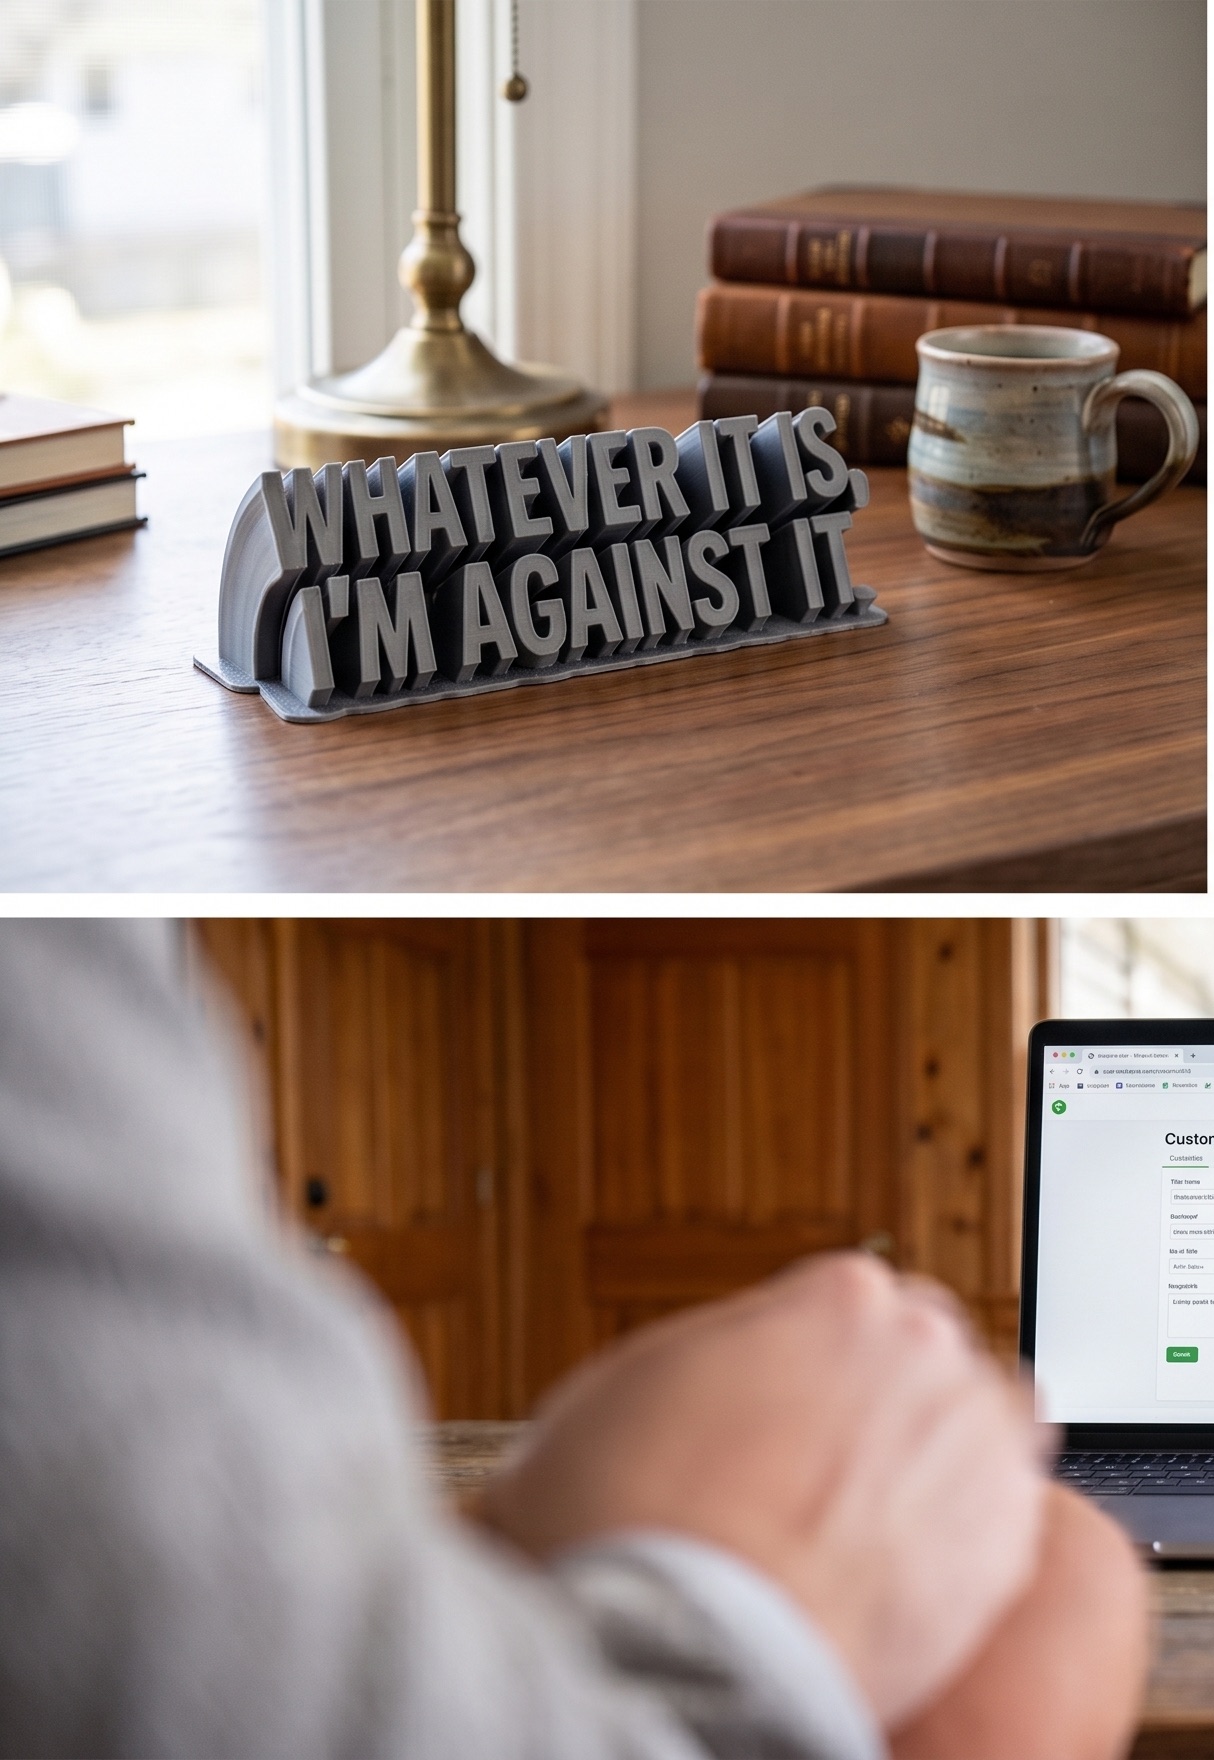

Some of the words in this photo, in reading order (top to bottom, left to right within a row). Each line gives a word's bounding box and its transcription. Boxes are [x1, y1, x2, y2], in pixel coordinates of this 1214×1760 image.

[262, 426, 691, 570] WHATEVER
[698, 414, 762, 512] IT
[775, 405, 870, 509] IS,
[300, 570, 437, 692] I'M
[462, 522, 772, 667] AGAINST
